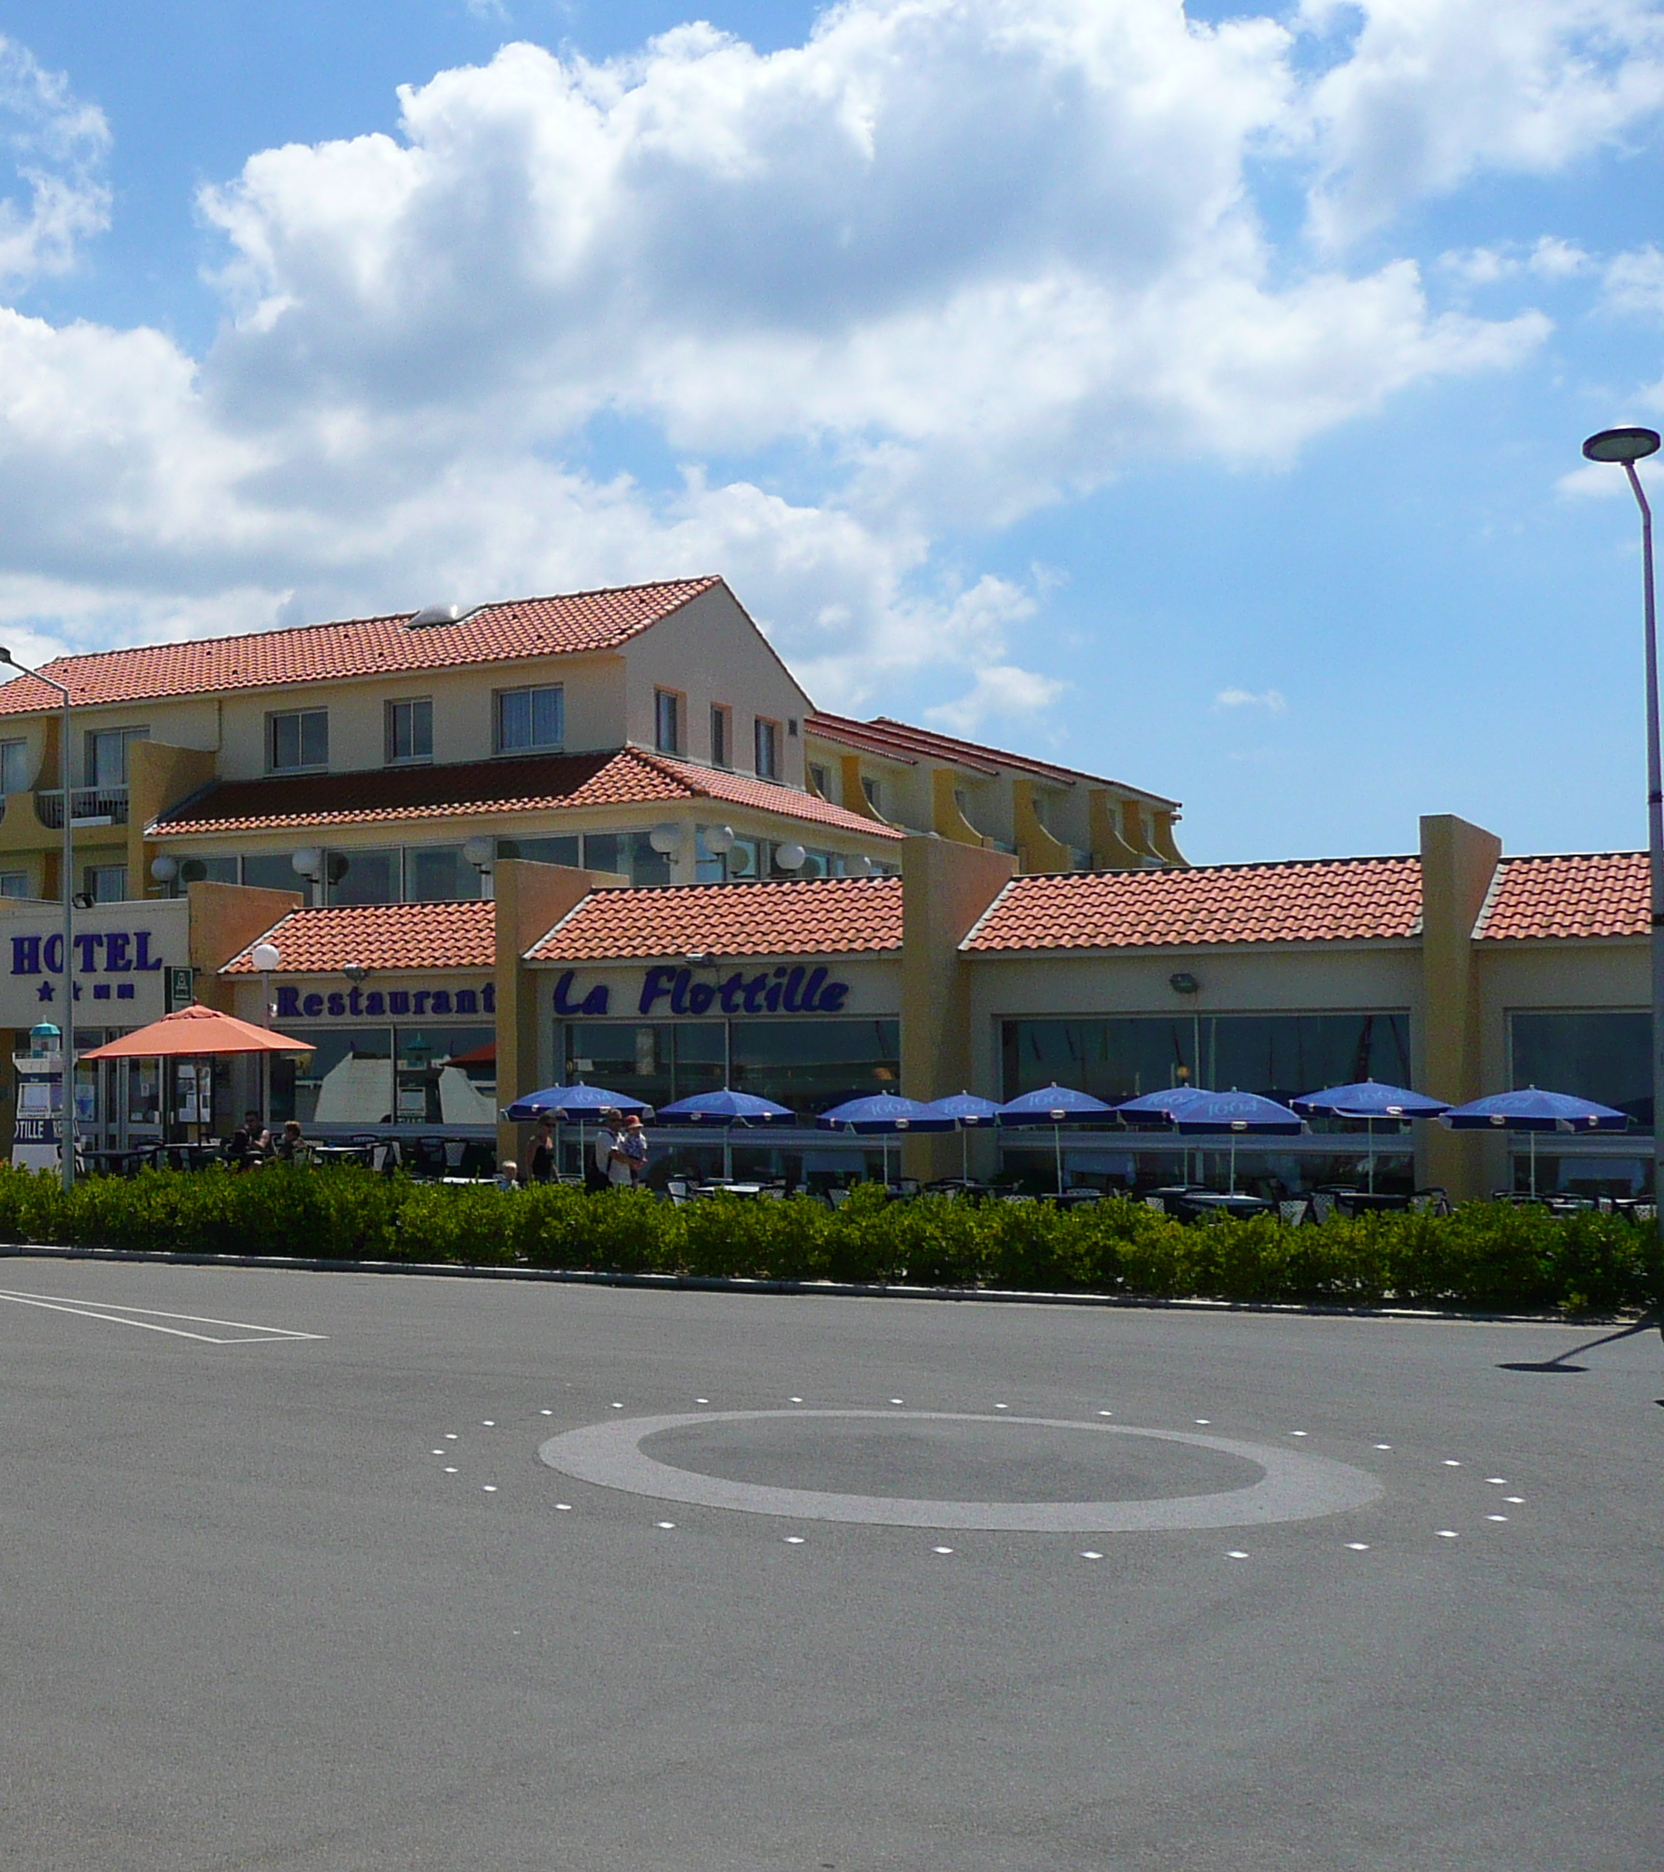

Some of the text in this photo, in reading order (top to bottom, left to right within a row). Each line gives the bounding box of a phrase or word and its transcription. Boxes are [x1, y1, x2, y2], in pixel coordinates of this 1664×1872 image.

[10, 932, 163, 974] HOTEL
[275, 982, 496, 1018] Restaurant
[552, 966, 849, 1015] La Flottille
